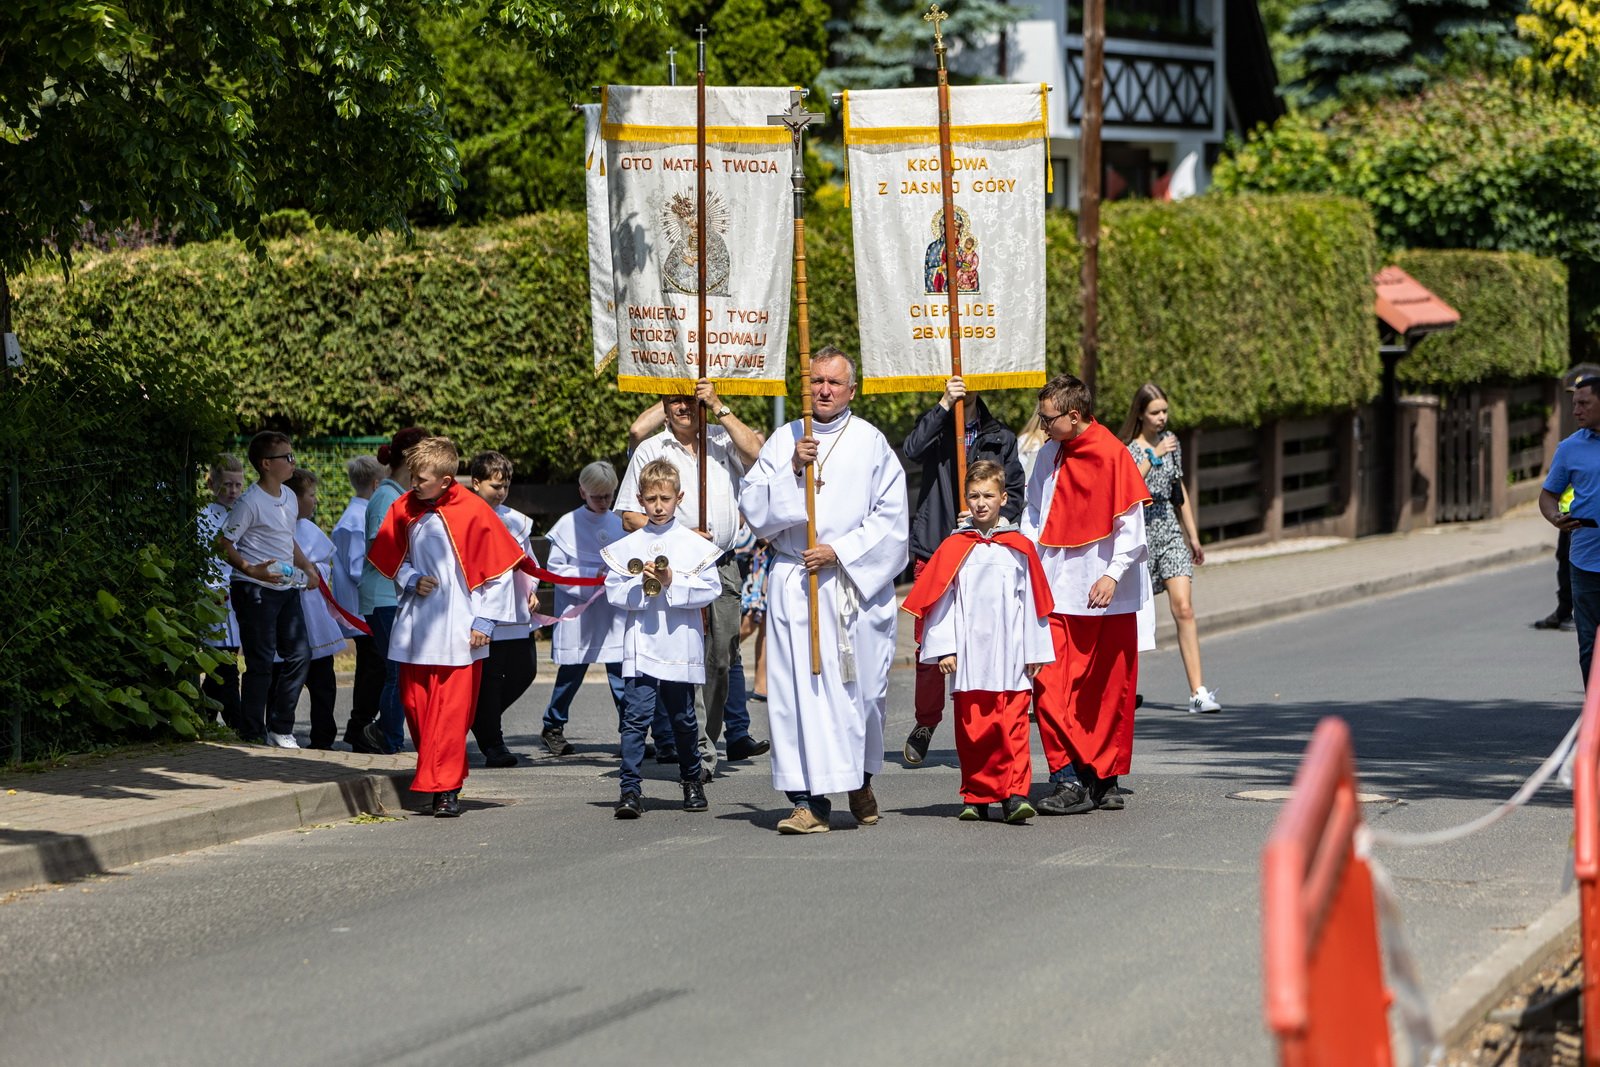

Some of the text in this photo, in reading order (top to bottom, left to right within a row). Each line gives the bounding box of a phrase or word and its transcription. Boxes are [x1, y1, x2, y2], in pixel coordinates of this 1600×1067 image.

[621, 157, 653, 171] OTO
[722, 159, 778, 174] TWOJA
[907, 155, 989, 172] KRÓOWA
[878, 176, 1016, 196] Z JASNJ GÓRY
[628, 305, 687, 321] PAMIETAJ
[727, 310, 769, 324] TYCH
[630, 323, 767, 347] KTÓRZY BDOWALI
[912, 325, 996, 340] 26.VI1993
